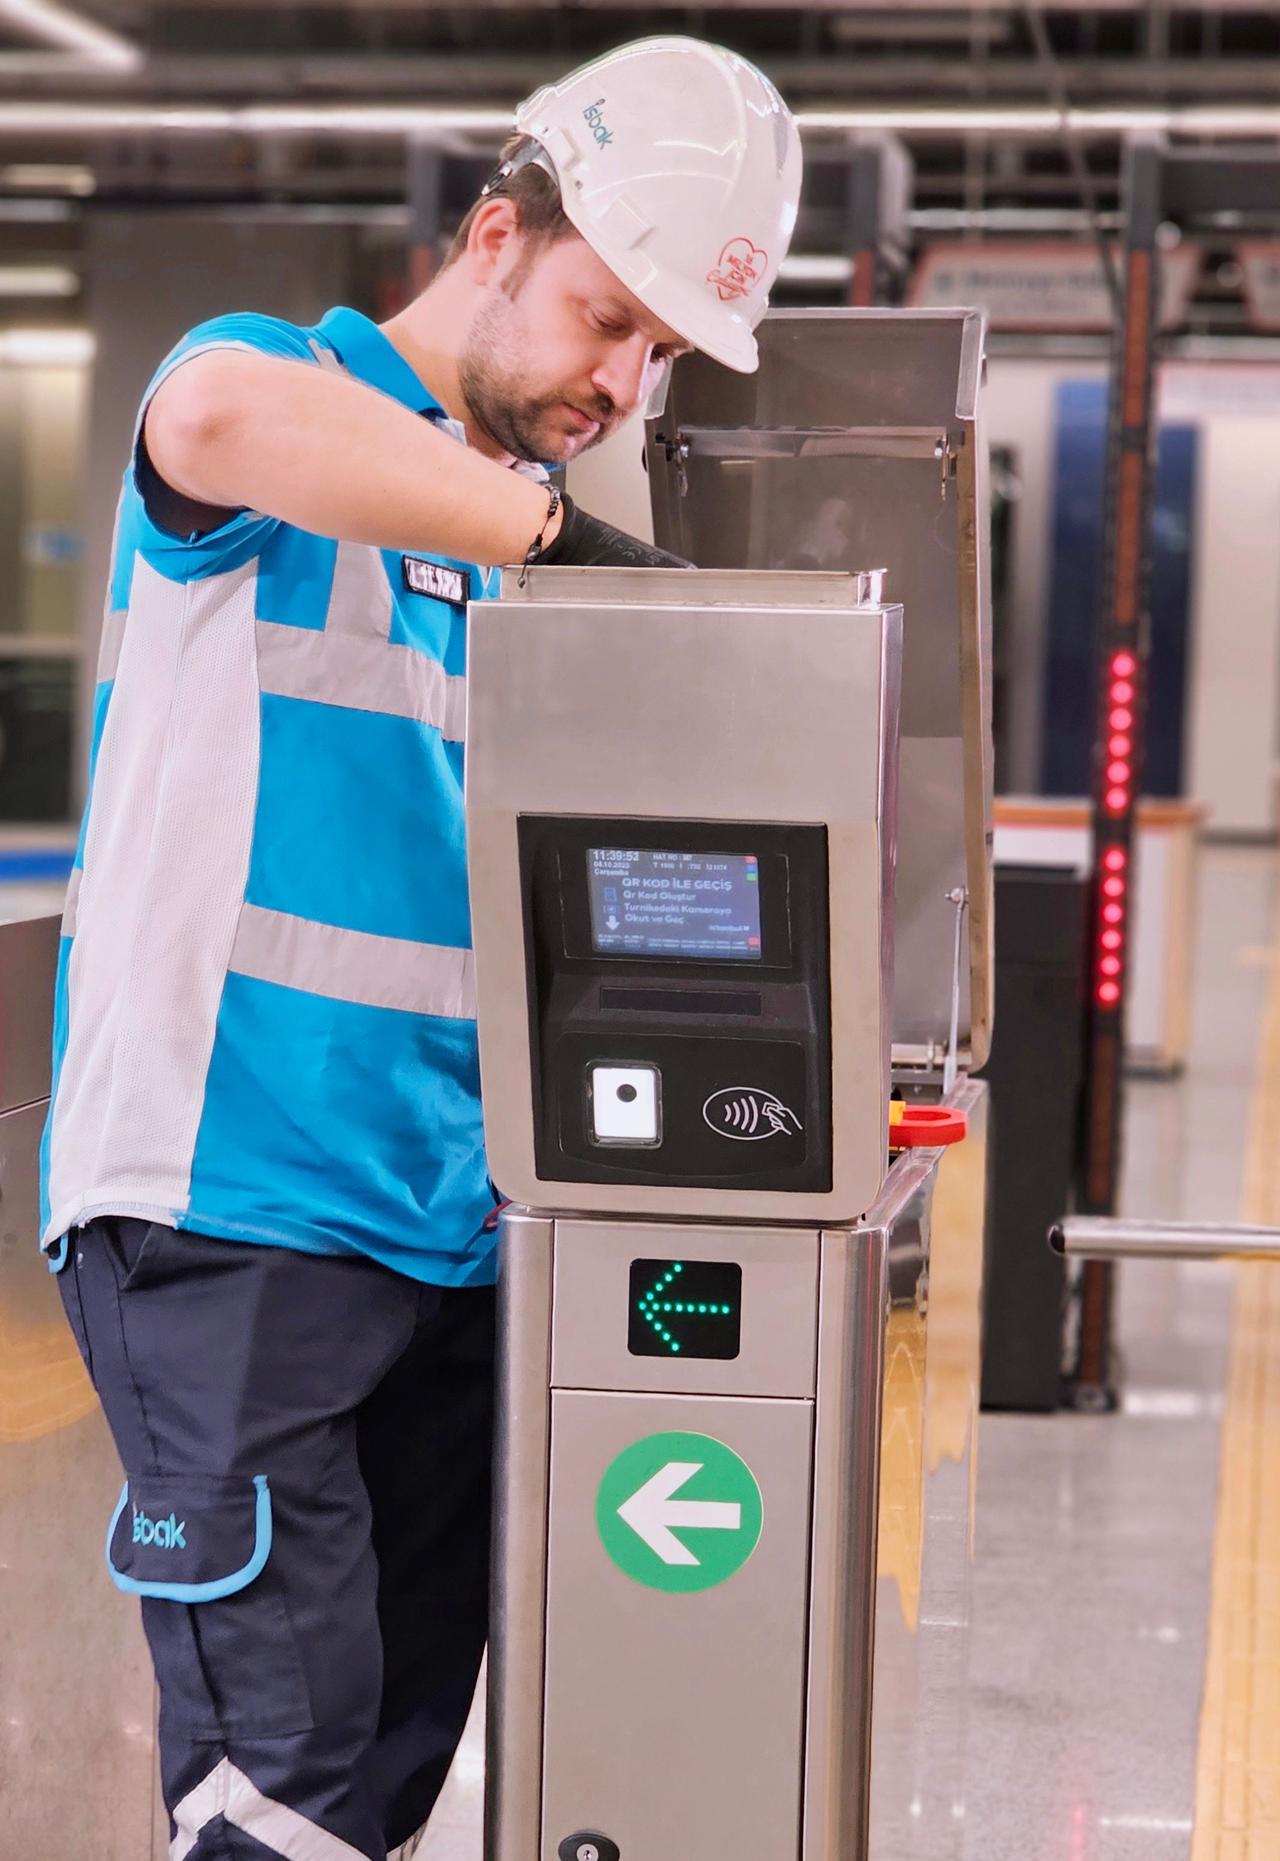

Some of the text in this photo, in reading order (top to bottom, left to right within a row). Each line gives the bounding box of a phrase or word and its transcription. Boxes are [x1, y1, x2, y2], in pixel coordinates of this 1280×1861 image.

[622, 877, 732, 891] QR KOD İLE GEÇİŞ
[623, 890, 696, 902] Qr Kod Oluştur
[624, 902, 732, 915] Turnikedeki Kameraya
[625, 913, 650, 922] Okut
[665, 914, 685, 924] Geç
